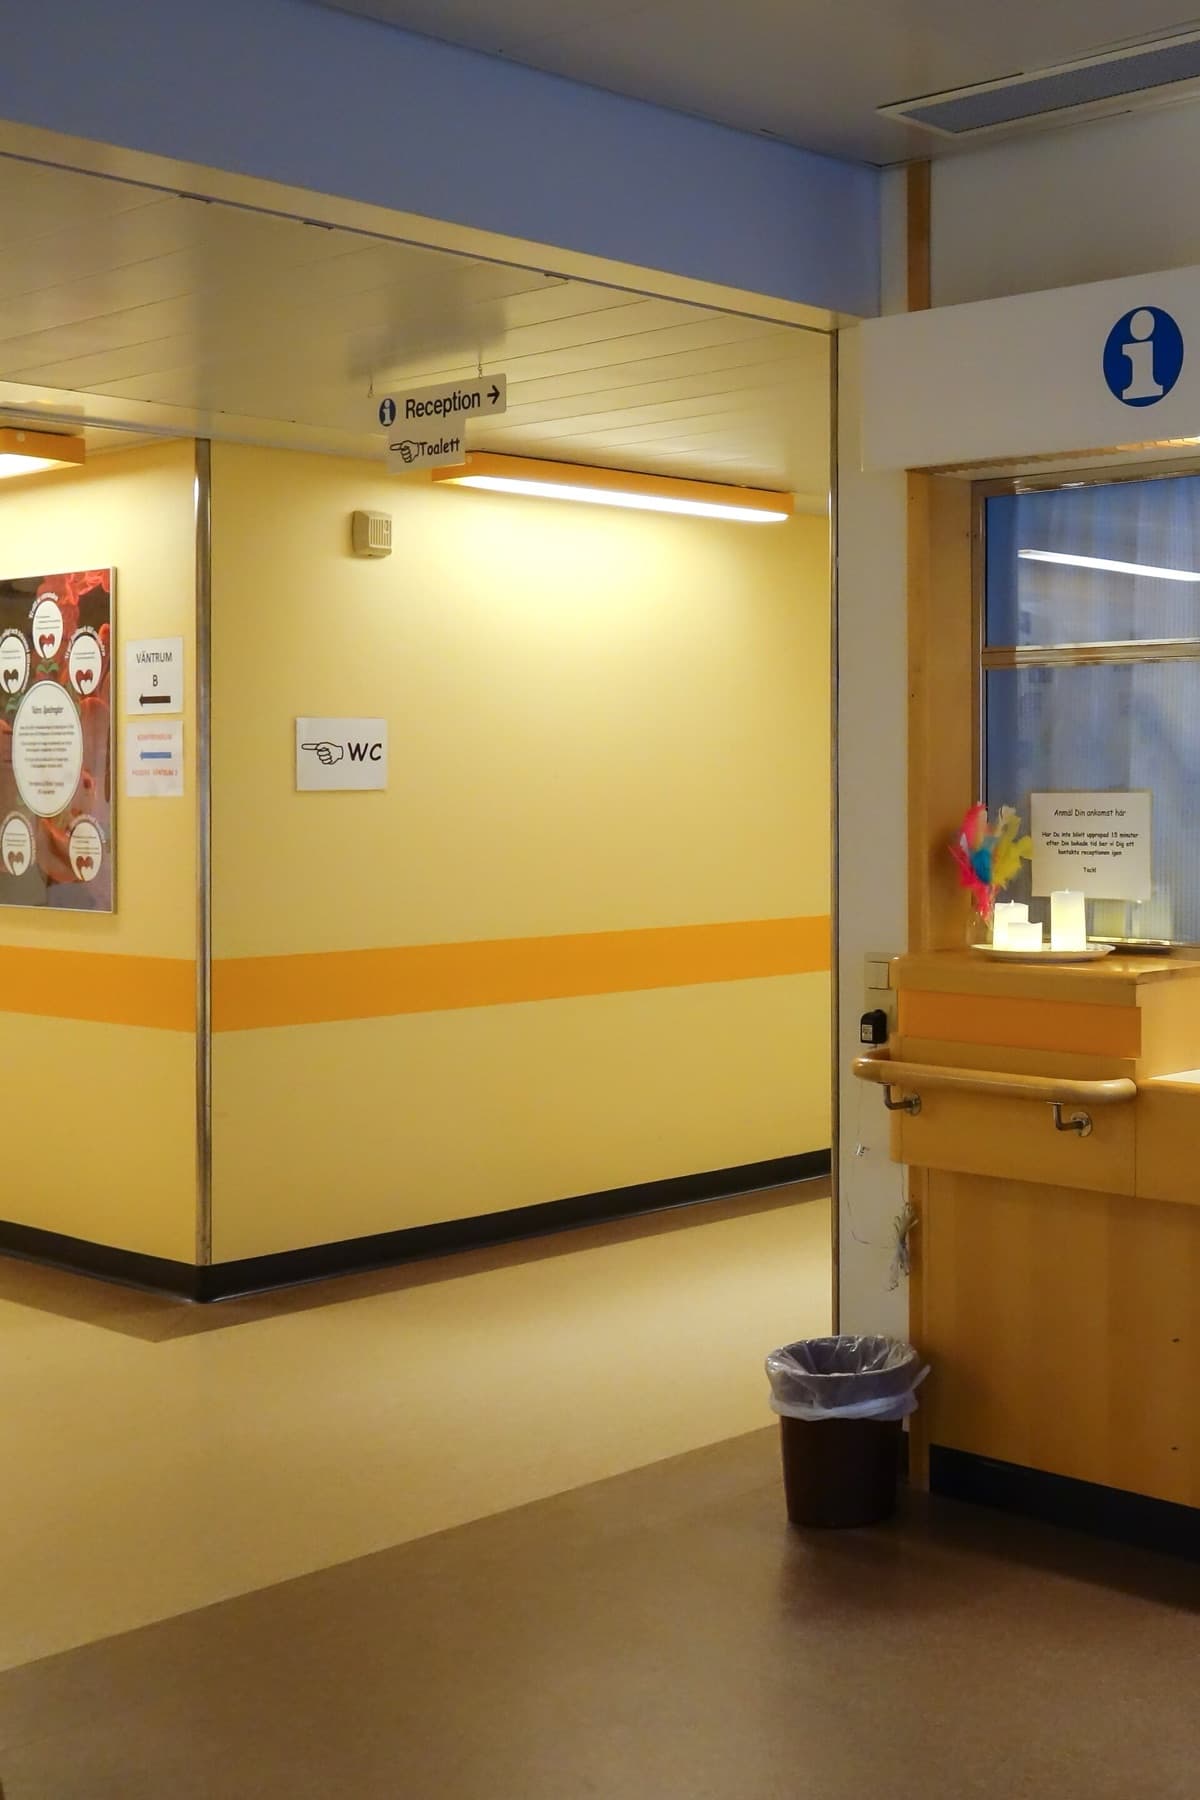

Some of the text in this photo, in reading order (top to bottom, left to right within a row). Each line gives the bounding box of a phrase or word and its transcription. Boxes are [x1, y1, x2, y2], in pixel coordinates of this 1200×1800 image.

[405, 390, 481, 419] Reception
[420, 438, 460, 456] Toalett
[136, 651, 173, 664] VÄNTRUM
[347, 742, 382, 762] WC
[1086, 809, 1113, 817] ankomst
